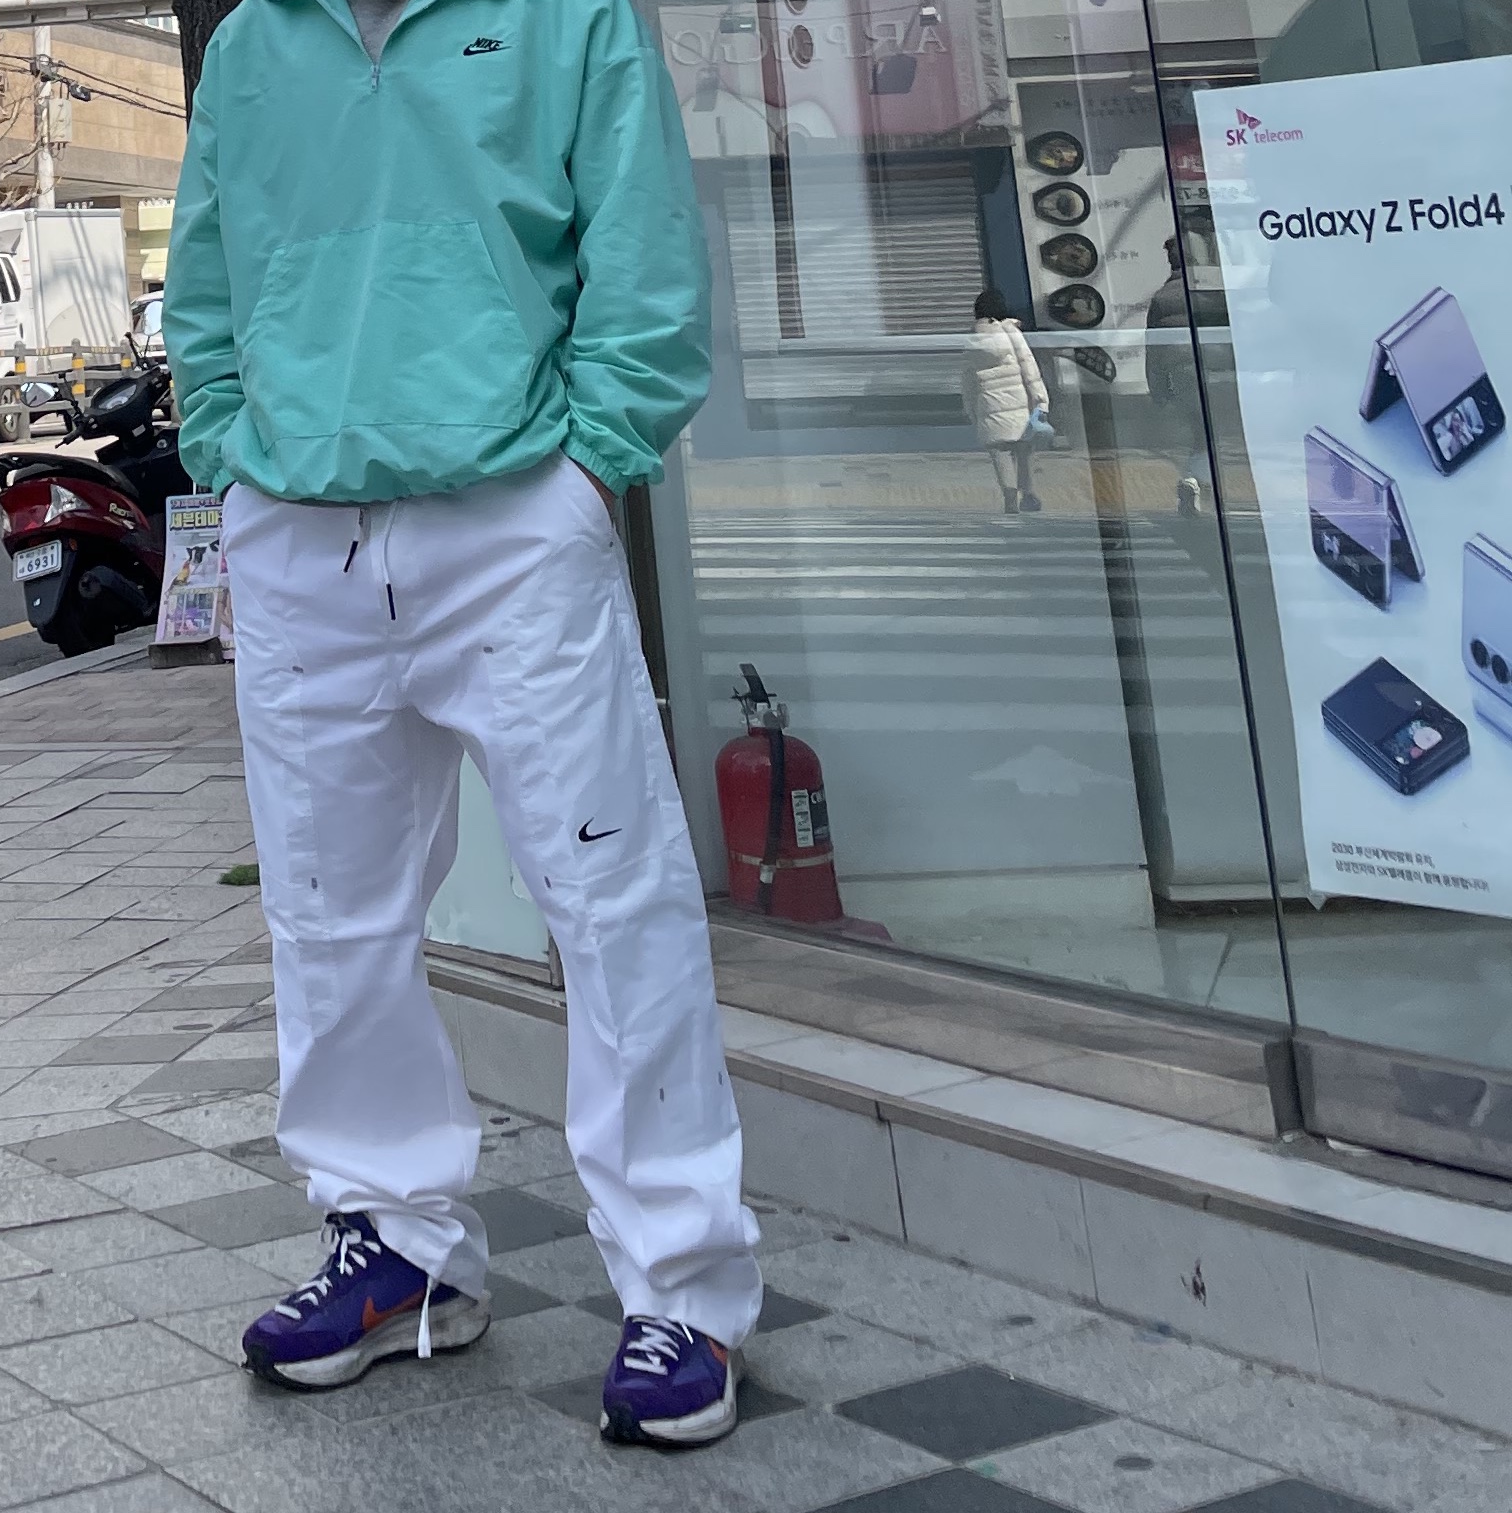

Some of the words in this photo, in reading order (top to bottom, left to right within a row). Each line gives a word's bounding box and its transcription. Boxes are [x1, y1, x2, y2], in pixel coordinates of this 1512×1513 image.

[470, 37, 504, 50] NIKE
[1226, 128, 1248, 147] SK
[1253, 128, 1304, 144] telecom
[1258, 206, 1376, 244] Galaxy
[1381, 200, 1403, 233] Z
[1408, 192, 1506, 231] Fold4
[27, 553, 55, 573] 6931
